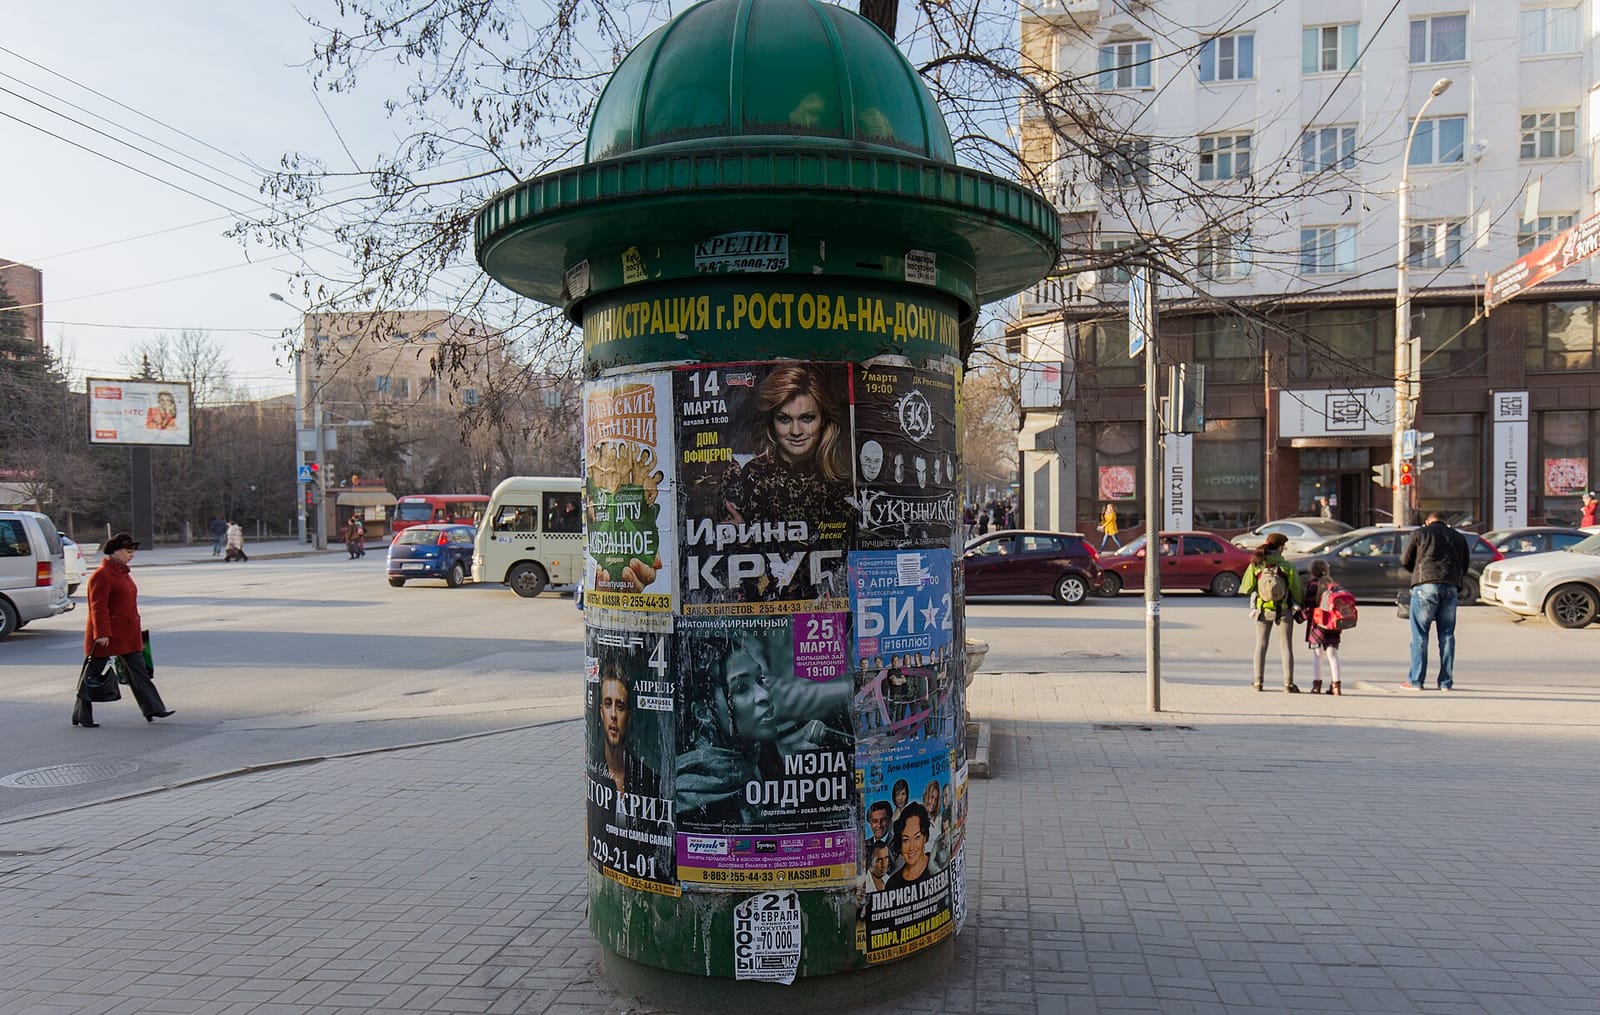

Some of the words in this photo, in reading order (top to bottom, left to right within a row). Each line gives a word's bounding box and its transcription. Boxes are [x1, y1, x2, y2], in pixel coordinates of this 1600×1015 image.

[696, 235, 787, 256] КРЕДИТ
[585, 295, 710, 350] ДМИНИСТРАЦИЯ
[689, 370, 720, 398] 14
[865, 383, 893, 394] 19:00
[683, 400, 728, 416] МАРТА
[711, 416, 729, 424] 19:00
[696, 432, 718, 447] ДОМ
[616, 502, 641, 523] ДГТУ
[589, 530, 654, 555] ИЗБРАННОЕ
[686, 517, 809, 551] Ирина
[687, 550, 842, 591] КРУГ
[858, 578, 865, 588] 9
[686, 604, 712, 615] ЗАКАЗ
[714, 603, 755, 614] БИЛЕТОВ:
[676, 620, 720, 629] АНАТОЛИЙ
[721, 617, 789, 629] КИРНИЧНЫЙ
[806, 619, 834, 640] 25
[678, 629, 786, 638] ПРЕДСТАВЛЯЕТ
[800, 641, 841, 654] МАРТА
[884, 637, 928, 650] #16ПЛЮС
[648, 636, 668, 677] 4
[806, 666, 836, 677] 19:00
[633, 680, 676, 694] АПРЕЛЯ
[785, 751, 847, 776] МЭЛА
[870, 765, 883, 785] 5
[745, 776, 847, 808] ОЛДРОН
[616, 790, 675, 830] КРИД
[592, 836, 657, 880] 229-21-01
[788, 867, 831, 880] KASSIR.RU
[762, 893, 796, 911] 21
[871, 884, 918, 912] ЛАРИСА
[753, 911, 798, 922] ФЕВРАЛЯ
[871, 910, 891, 922] СЕРГЕЙ
